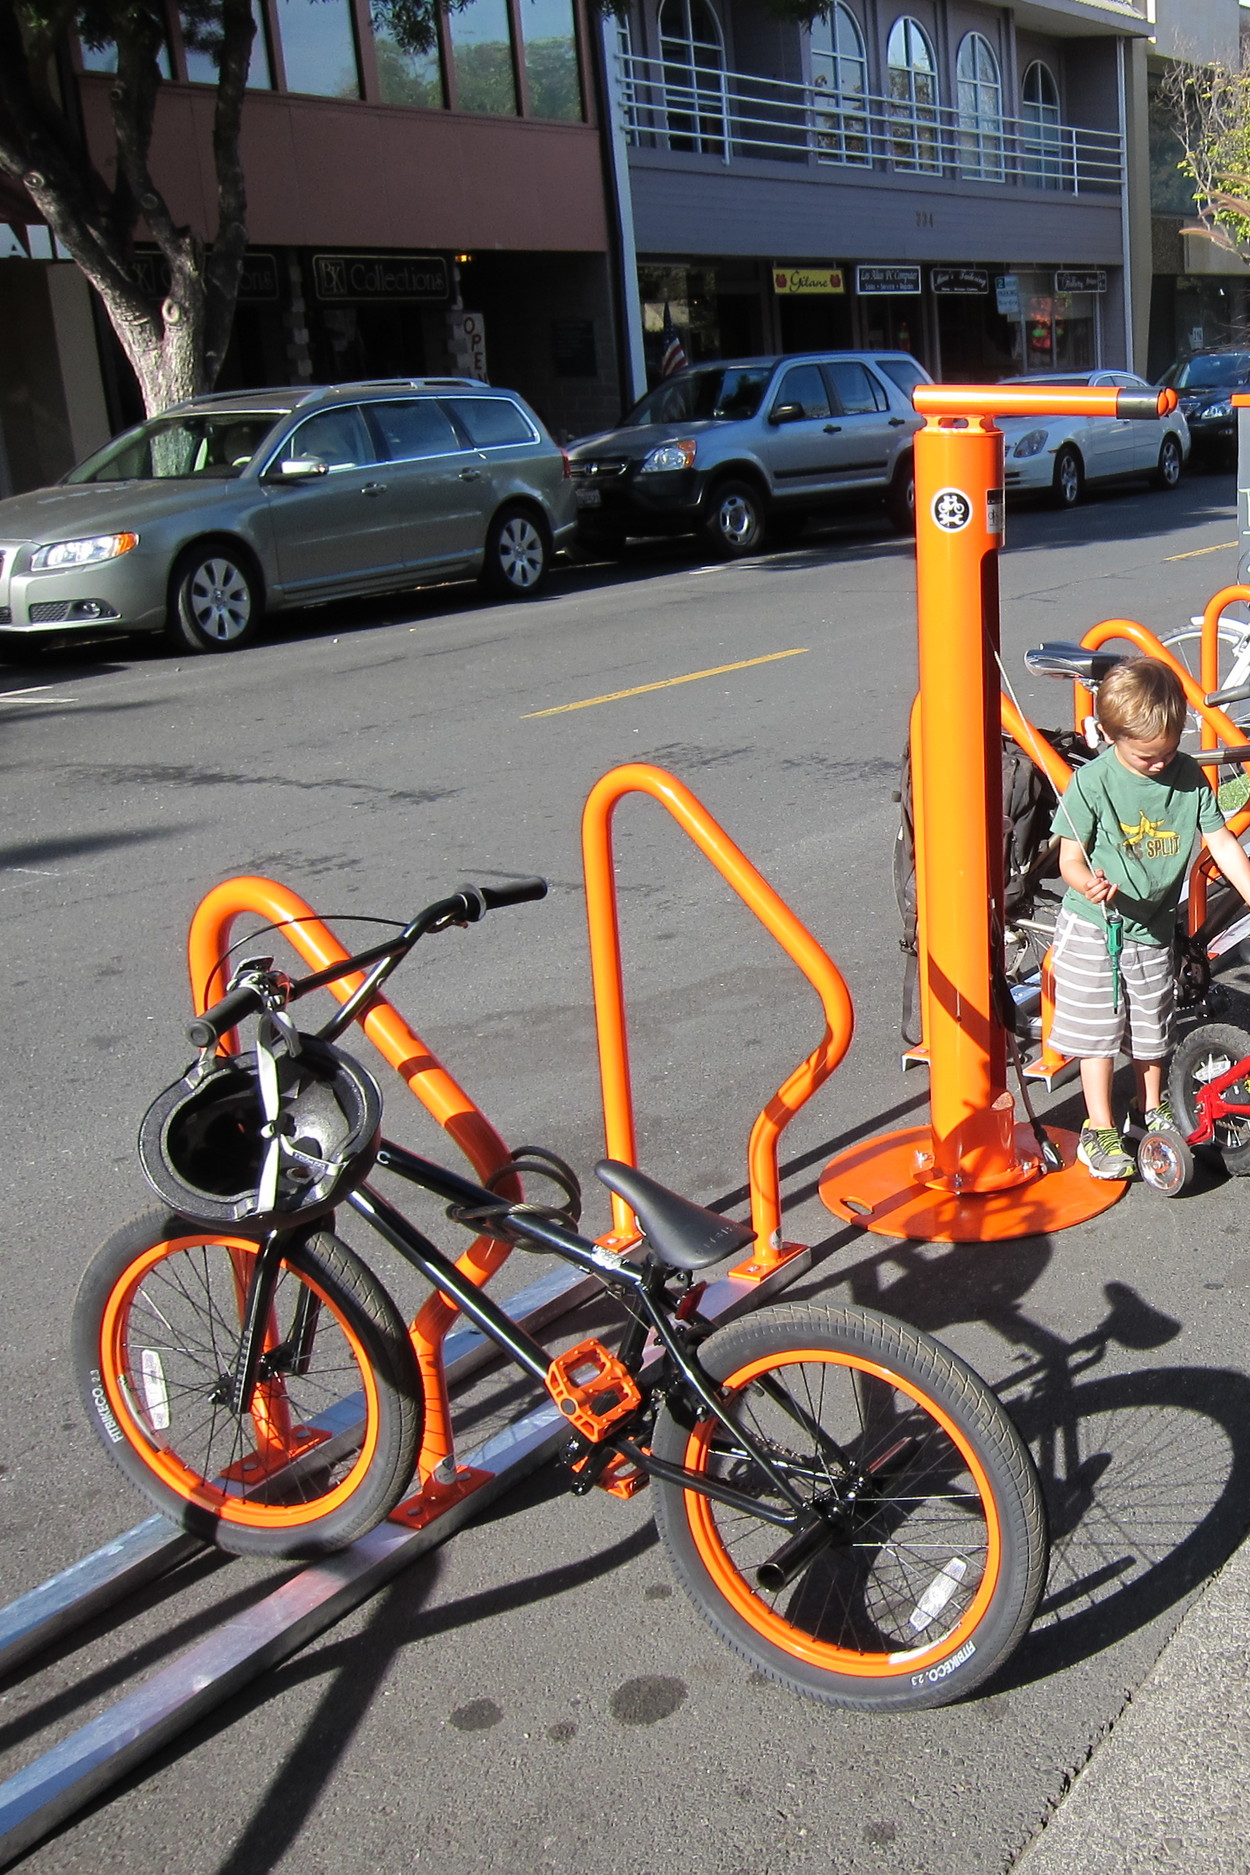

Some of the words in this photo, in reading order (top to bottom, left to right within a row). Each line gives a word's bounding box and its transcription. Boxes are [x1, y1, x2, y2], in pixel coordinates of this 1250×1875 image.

[350, 263, 444, 291] Collections
[789, 270, 829, 292] Gitane
[1146, 835, 1181, 859] SPLIT
